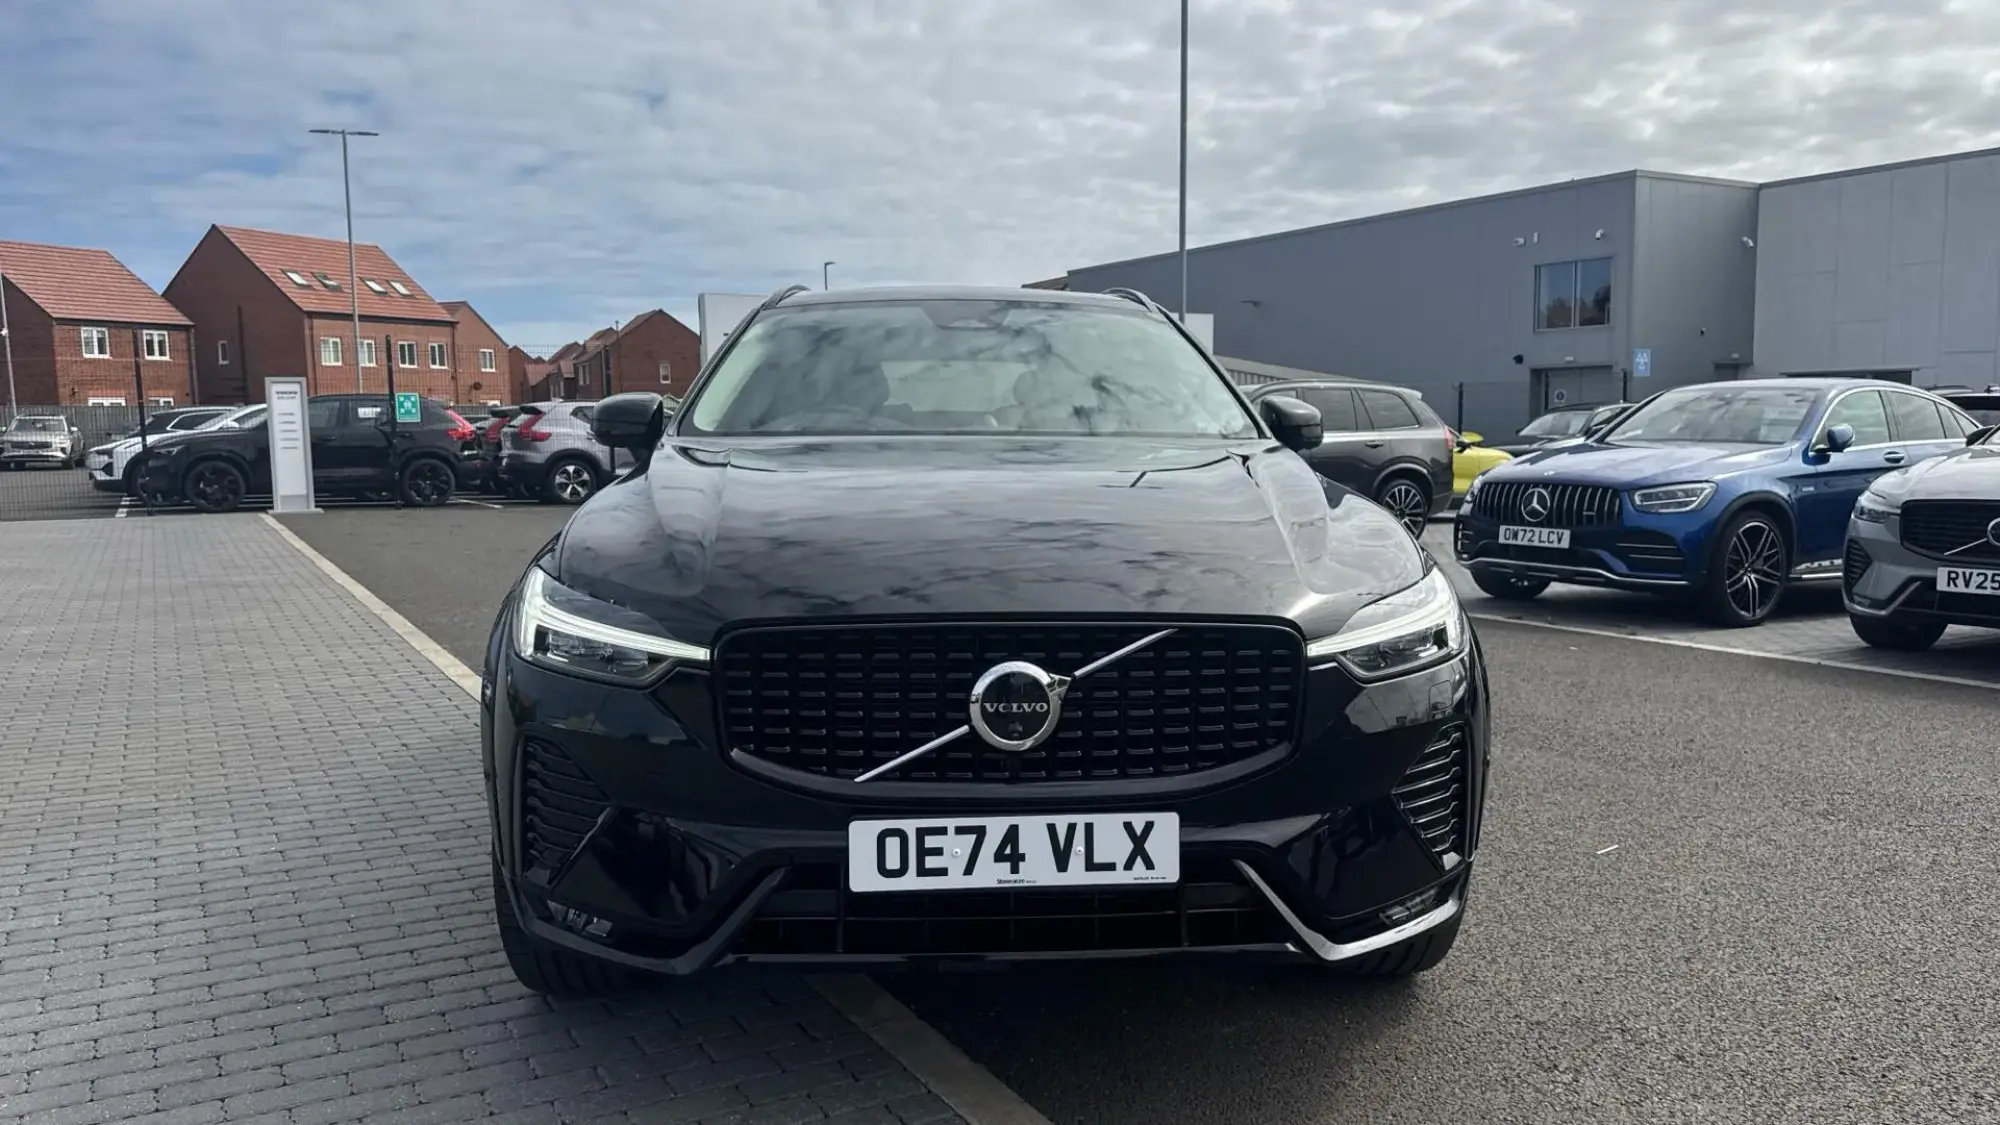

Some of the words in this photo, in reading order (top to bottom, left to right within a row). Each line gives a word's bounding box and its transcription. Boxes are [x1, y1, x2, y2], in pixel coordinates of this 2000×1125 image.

[1504, 527, 1535, 543] OW72
[1538, 529, 1564, 545] LCV
[1946, 570, 2000, 591] RV25
[983, 702, 1048, 713] VOLVO
[876, 823, 1026, 878] OE74
[1046, 820, 1155, 873] VLX
